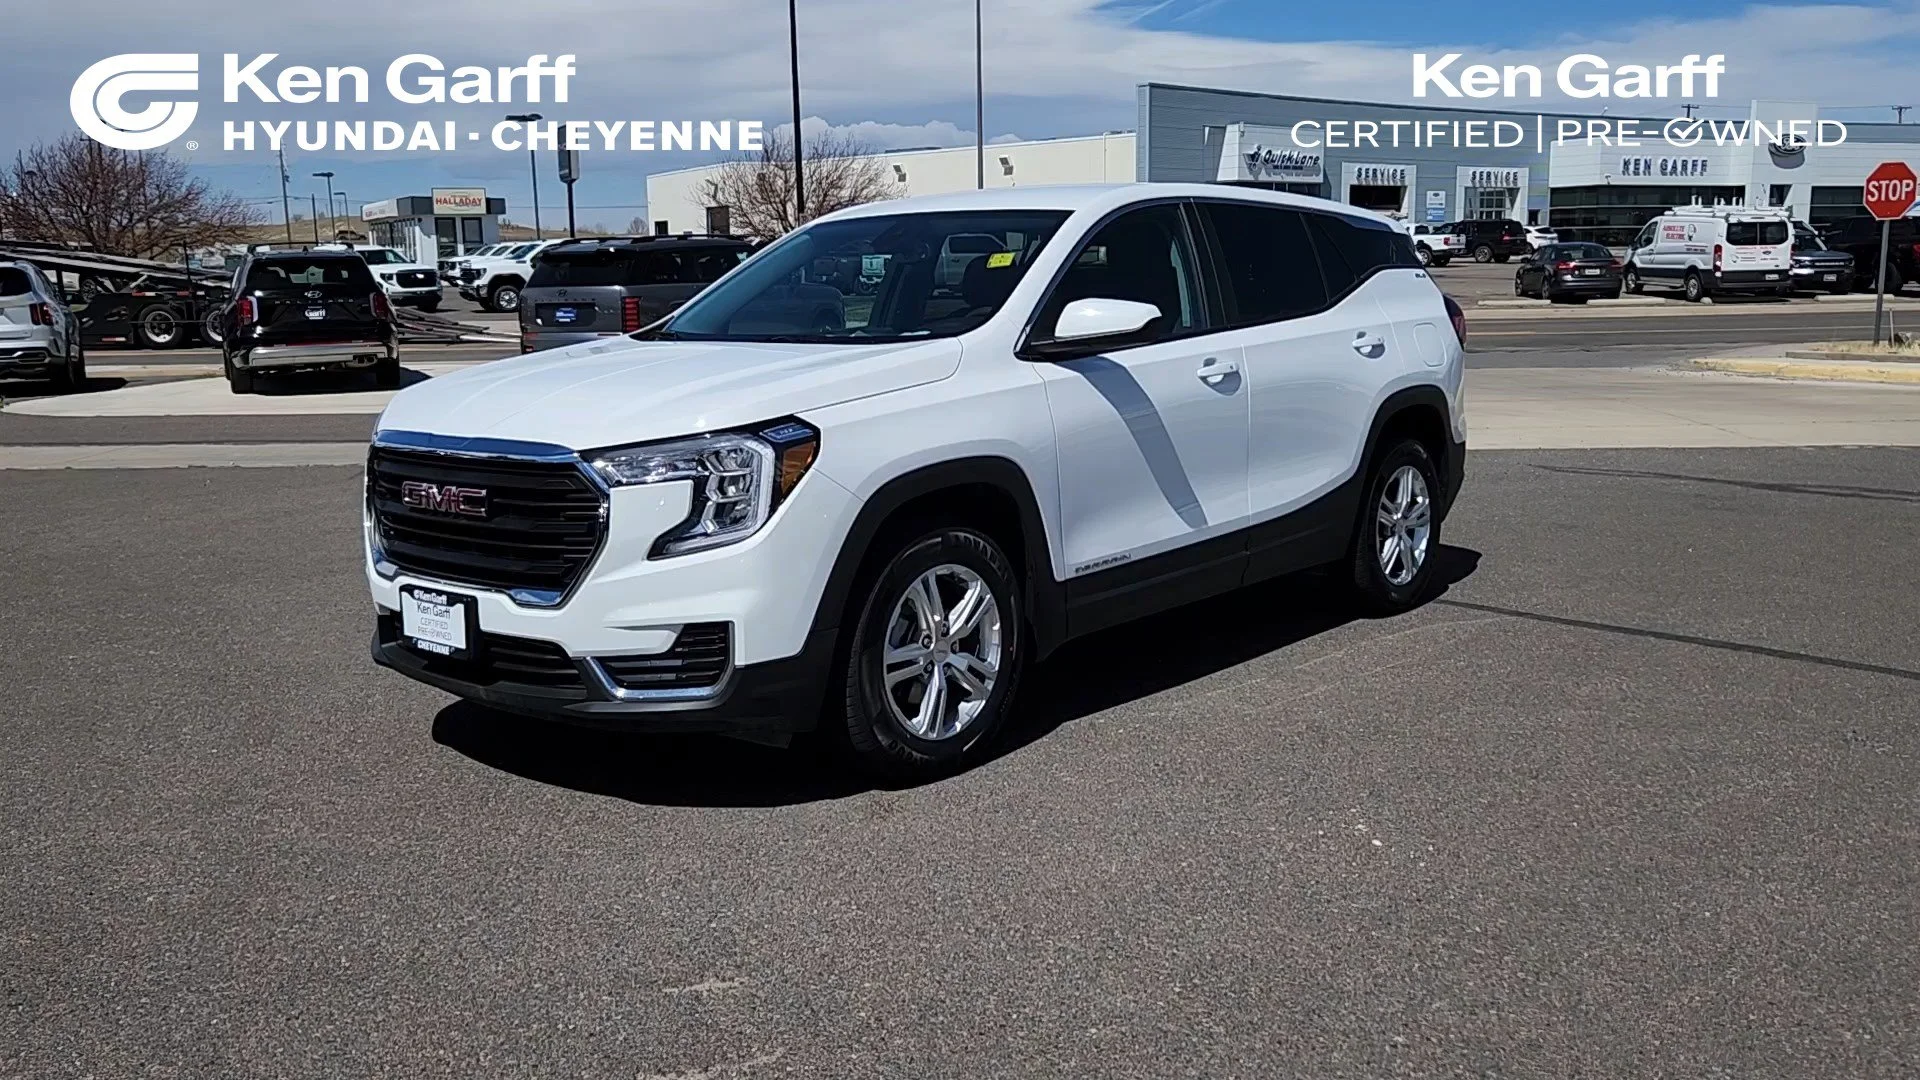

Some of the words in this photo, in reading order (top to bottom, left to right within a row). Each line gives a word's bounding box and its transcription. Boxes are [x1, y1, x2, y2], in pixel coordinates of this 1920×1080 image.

[1622, 157, 1653, 173] KEN
[1660, 158, 1708, 174] GARFF
[1356, 167, 1406, 181] SERVICE
[1471, 170, 1519, 182] SERVICE
[1867, 179, 1914, 202] STOP
[435, 197, 482, 207] HALLADAY
[401, 480, 487, 517] GMC
[416, 601, 432, 615] Ken
[432, 605, 451, 620] Garff
[420, 616, 449, 630] CERTIFIED
[417, 640, 450, 656] CHEYENNE
